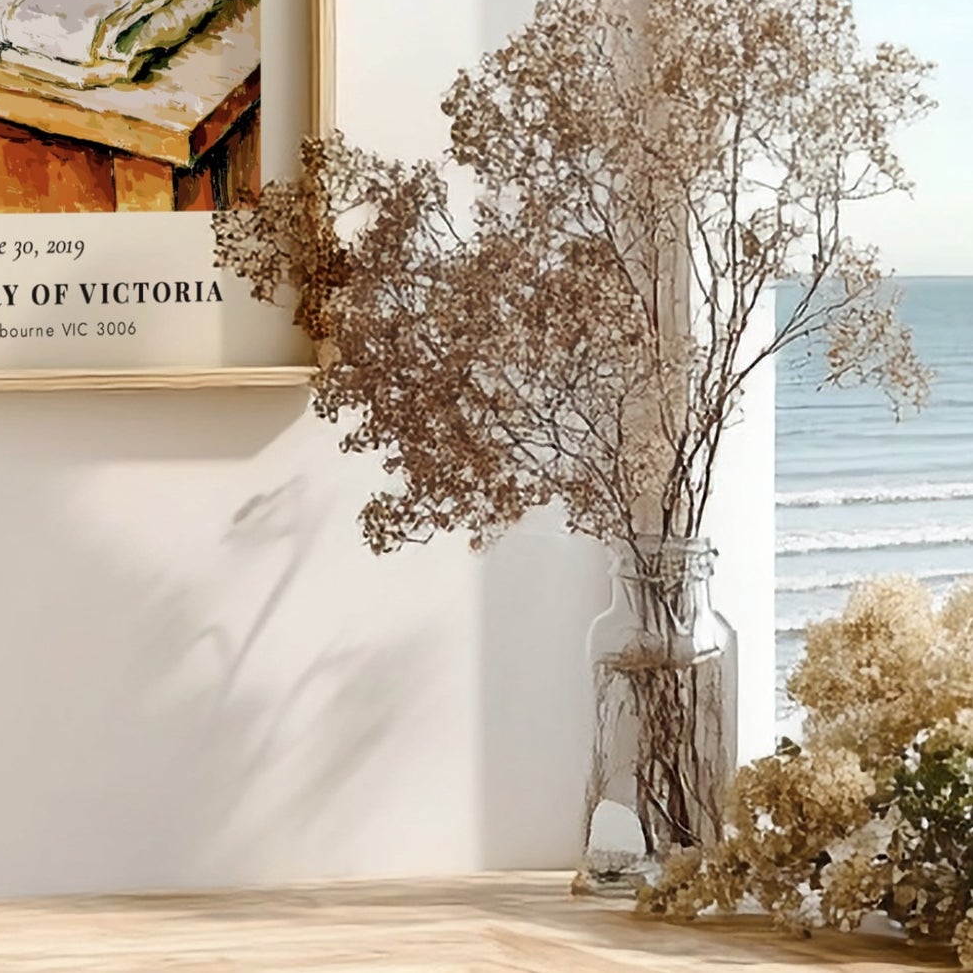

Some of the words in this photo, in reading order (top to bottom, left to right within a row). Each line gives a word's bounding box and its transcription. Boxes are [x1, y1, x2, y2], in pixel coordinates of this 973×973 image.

[12, 241, 39, 262] 30,
[46, 240, 85, 261] 2019
[31, 283, 69, 306] OF
[78, 281, 223, 305] VICTORIA
[62, 322, 88, 337] VIC
[97, 321, 136, 336] 3006
